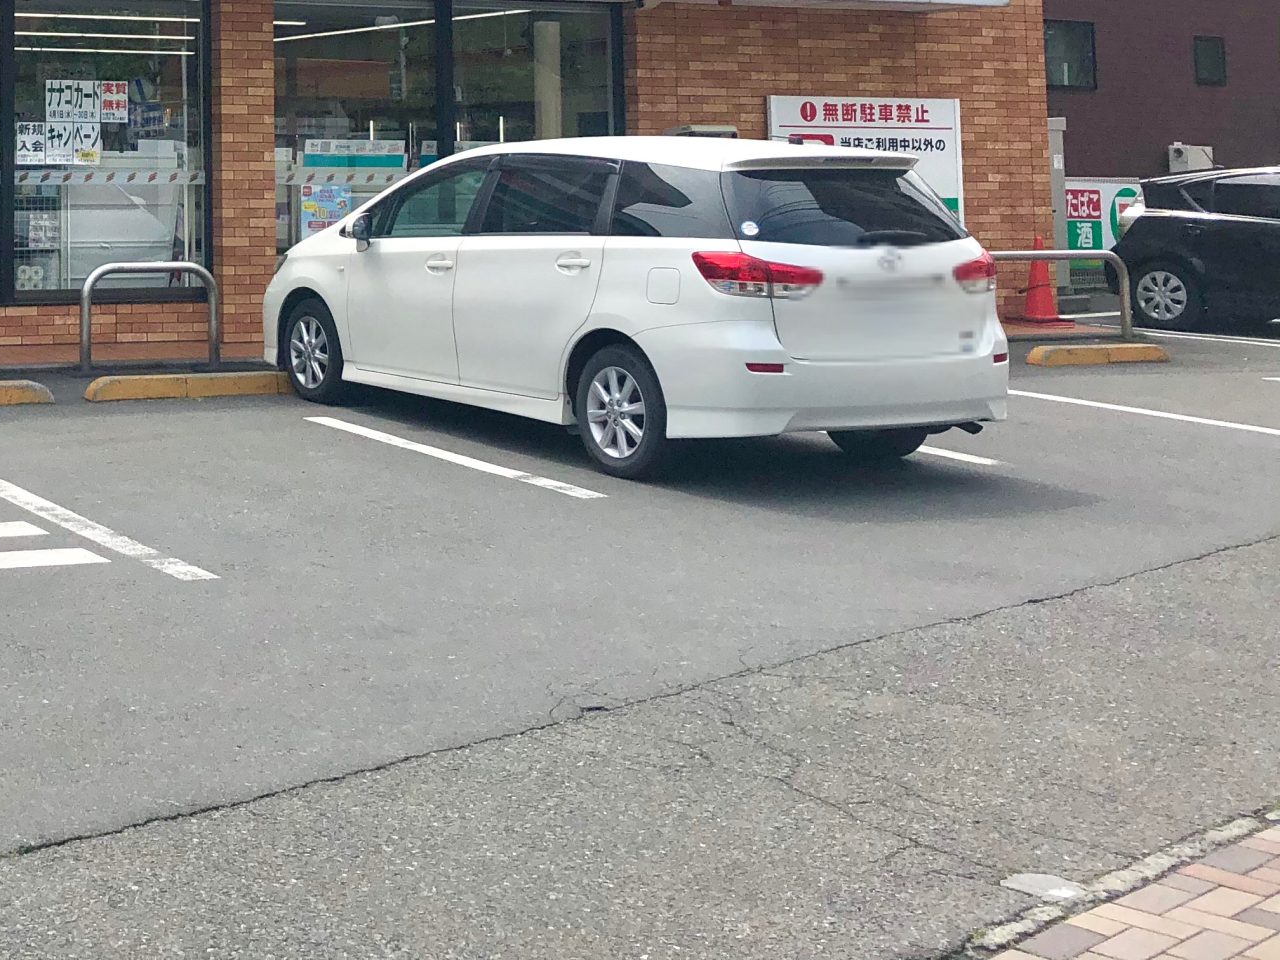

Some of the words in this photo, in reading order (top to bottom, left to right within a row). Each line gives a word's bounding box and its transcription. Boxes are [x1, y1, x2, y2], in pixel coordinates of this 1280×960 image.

[102, 82, 128, 95] 実質
[102, 99, 128, 112] 無料
[822, 102, 930, 123] 無断駐車禁止
[18, 123, 44, 137] 新規
[48, 124, 100, 149] キャンペーン
[18, 140, 44, 153] 入会
[840, 137, 946, 152] 当店ご利用中以外の
[1066, 192, 1100, 217] たばこ
[1076, 222, 1093, 248] 酒
